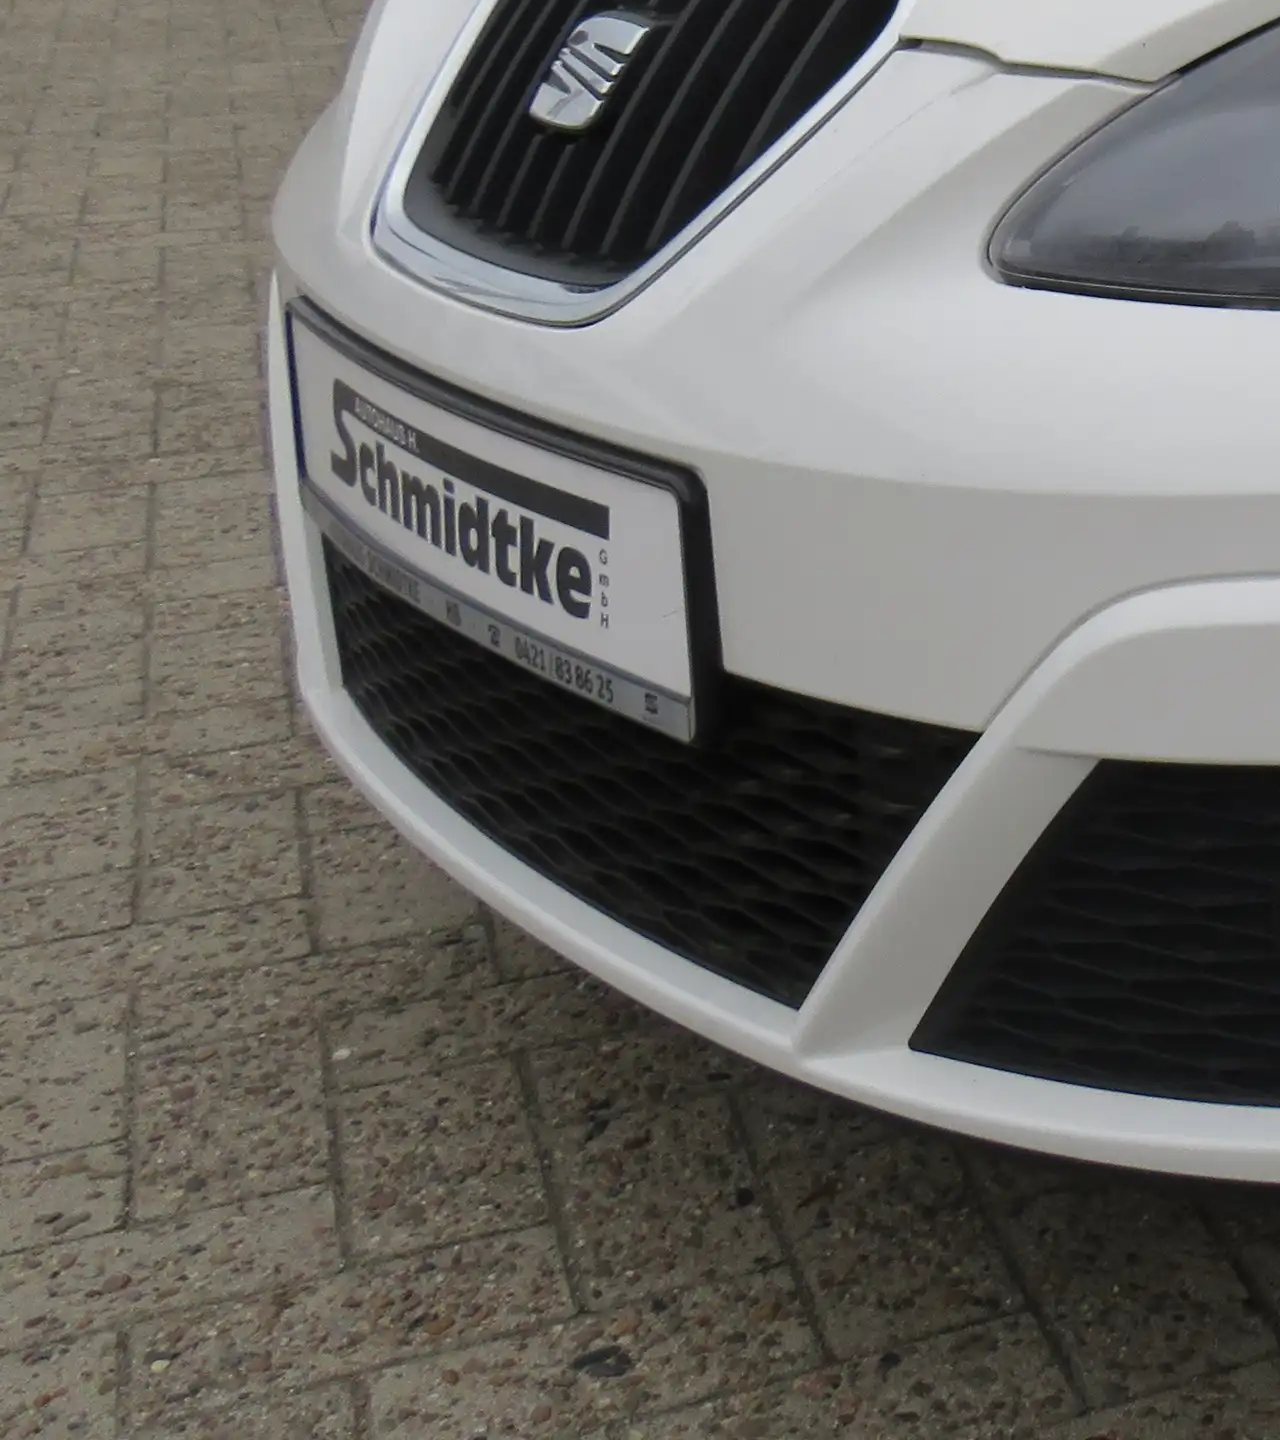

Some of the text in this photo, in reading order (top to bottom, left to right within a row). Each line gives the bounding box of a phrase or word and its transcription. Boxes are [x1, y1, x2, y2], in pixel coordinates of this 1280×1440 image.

[330, 378, 592, 620] Schmidtke
[514, 635, 546, 672] 0421
[598, 674, 614, 704] 25
